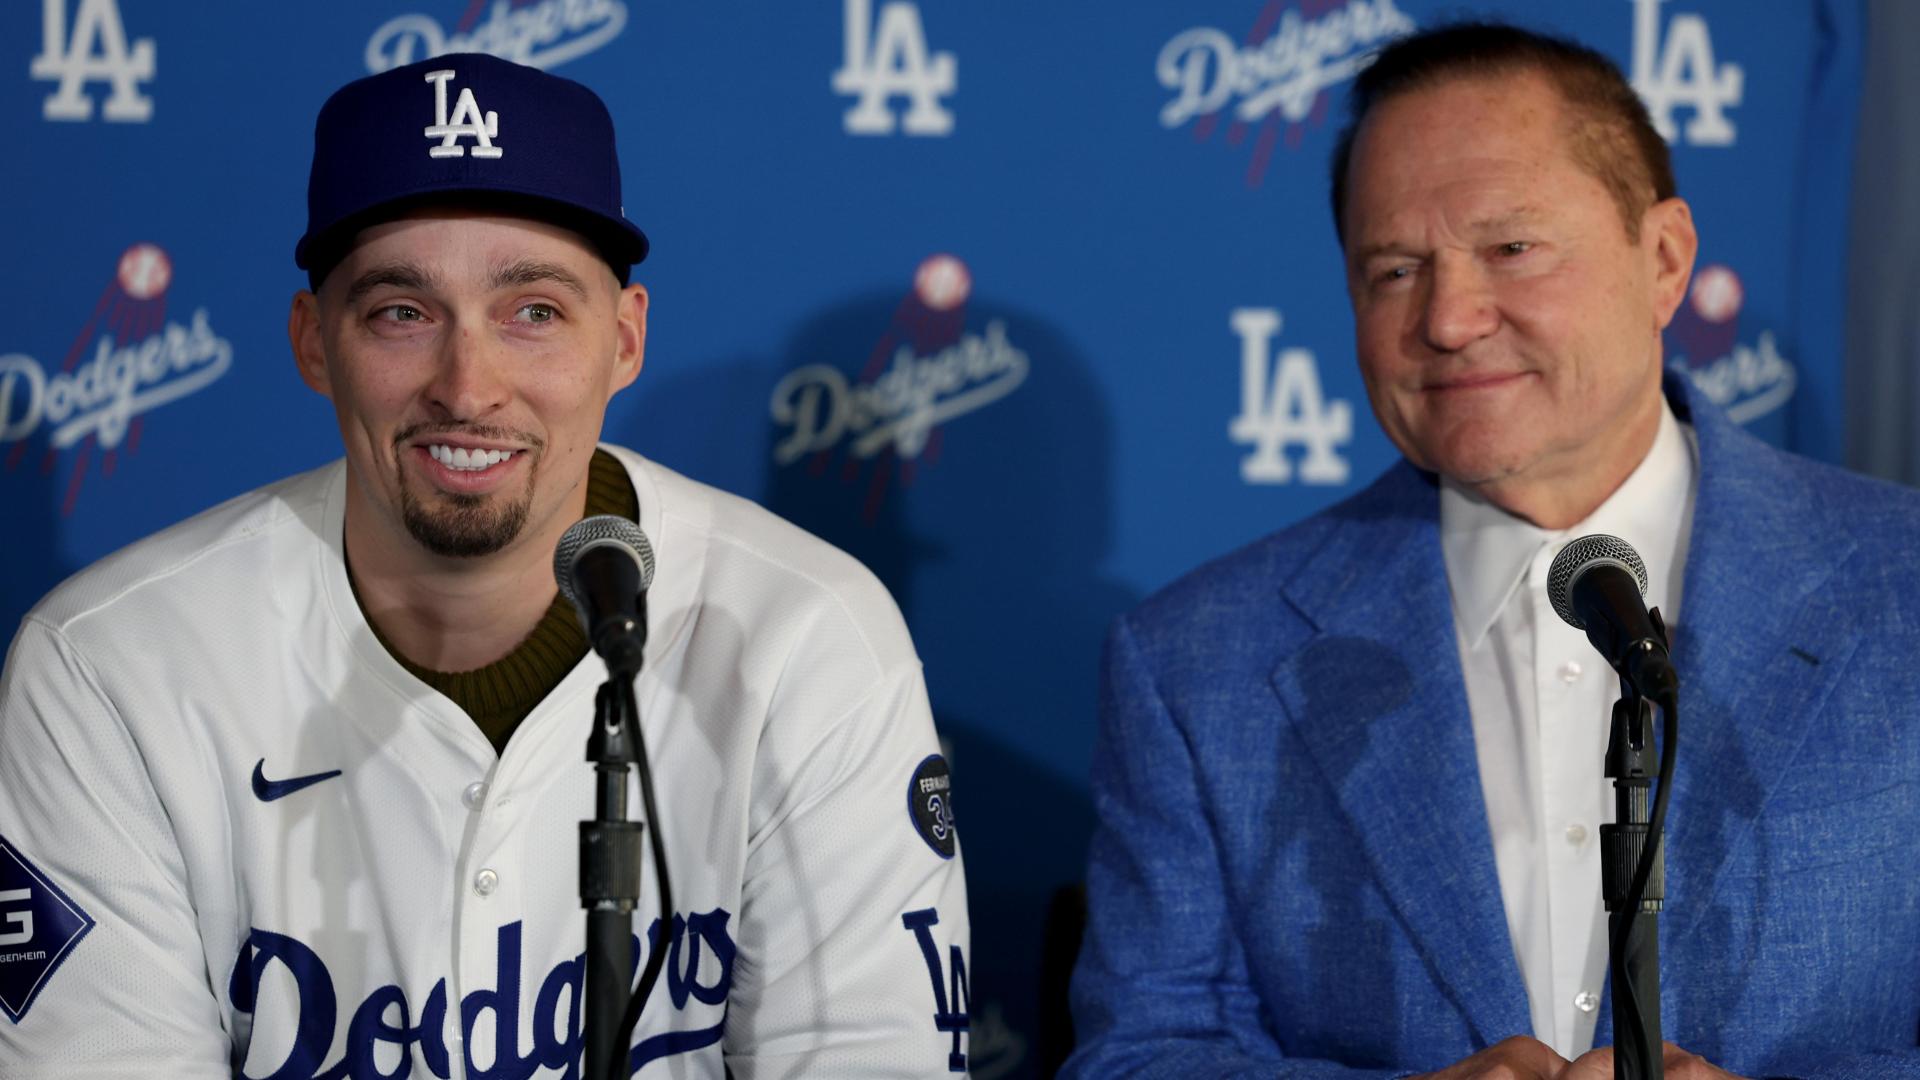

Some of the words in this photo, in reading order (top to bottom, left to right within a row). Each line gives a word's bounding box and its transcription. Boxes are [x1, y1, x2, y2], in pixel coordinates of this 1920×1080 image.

[31, 0, 157, 122] LA
[424, 69, 503, 159] LA
[831, 0, 958, 136] LA
[1155, 0, 1416, 128] Dodgers
[1630, 0, 1743, 145] LA
[0, 307, 232, 449] Dodgers
[771, 317, 1030, 465] Dodgers
[1229, 307, 1352, 485] LA
[229, 907, 737, 1080] Dodgrs
